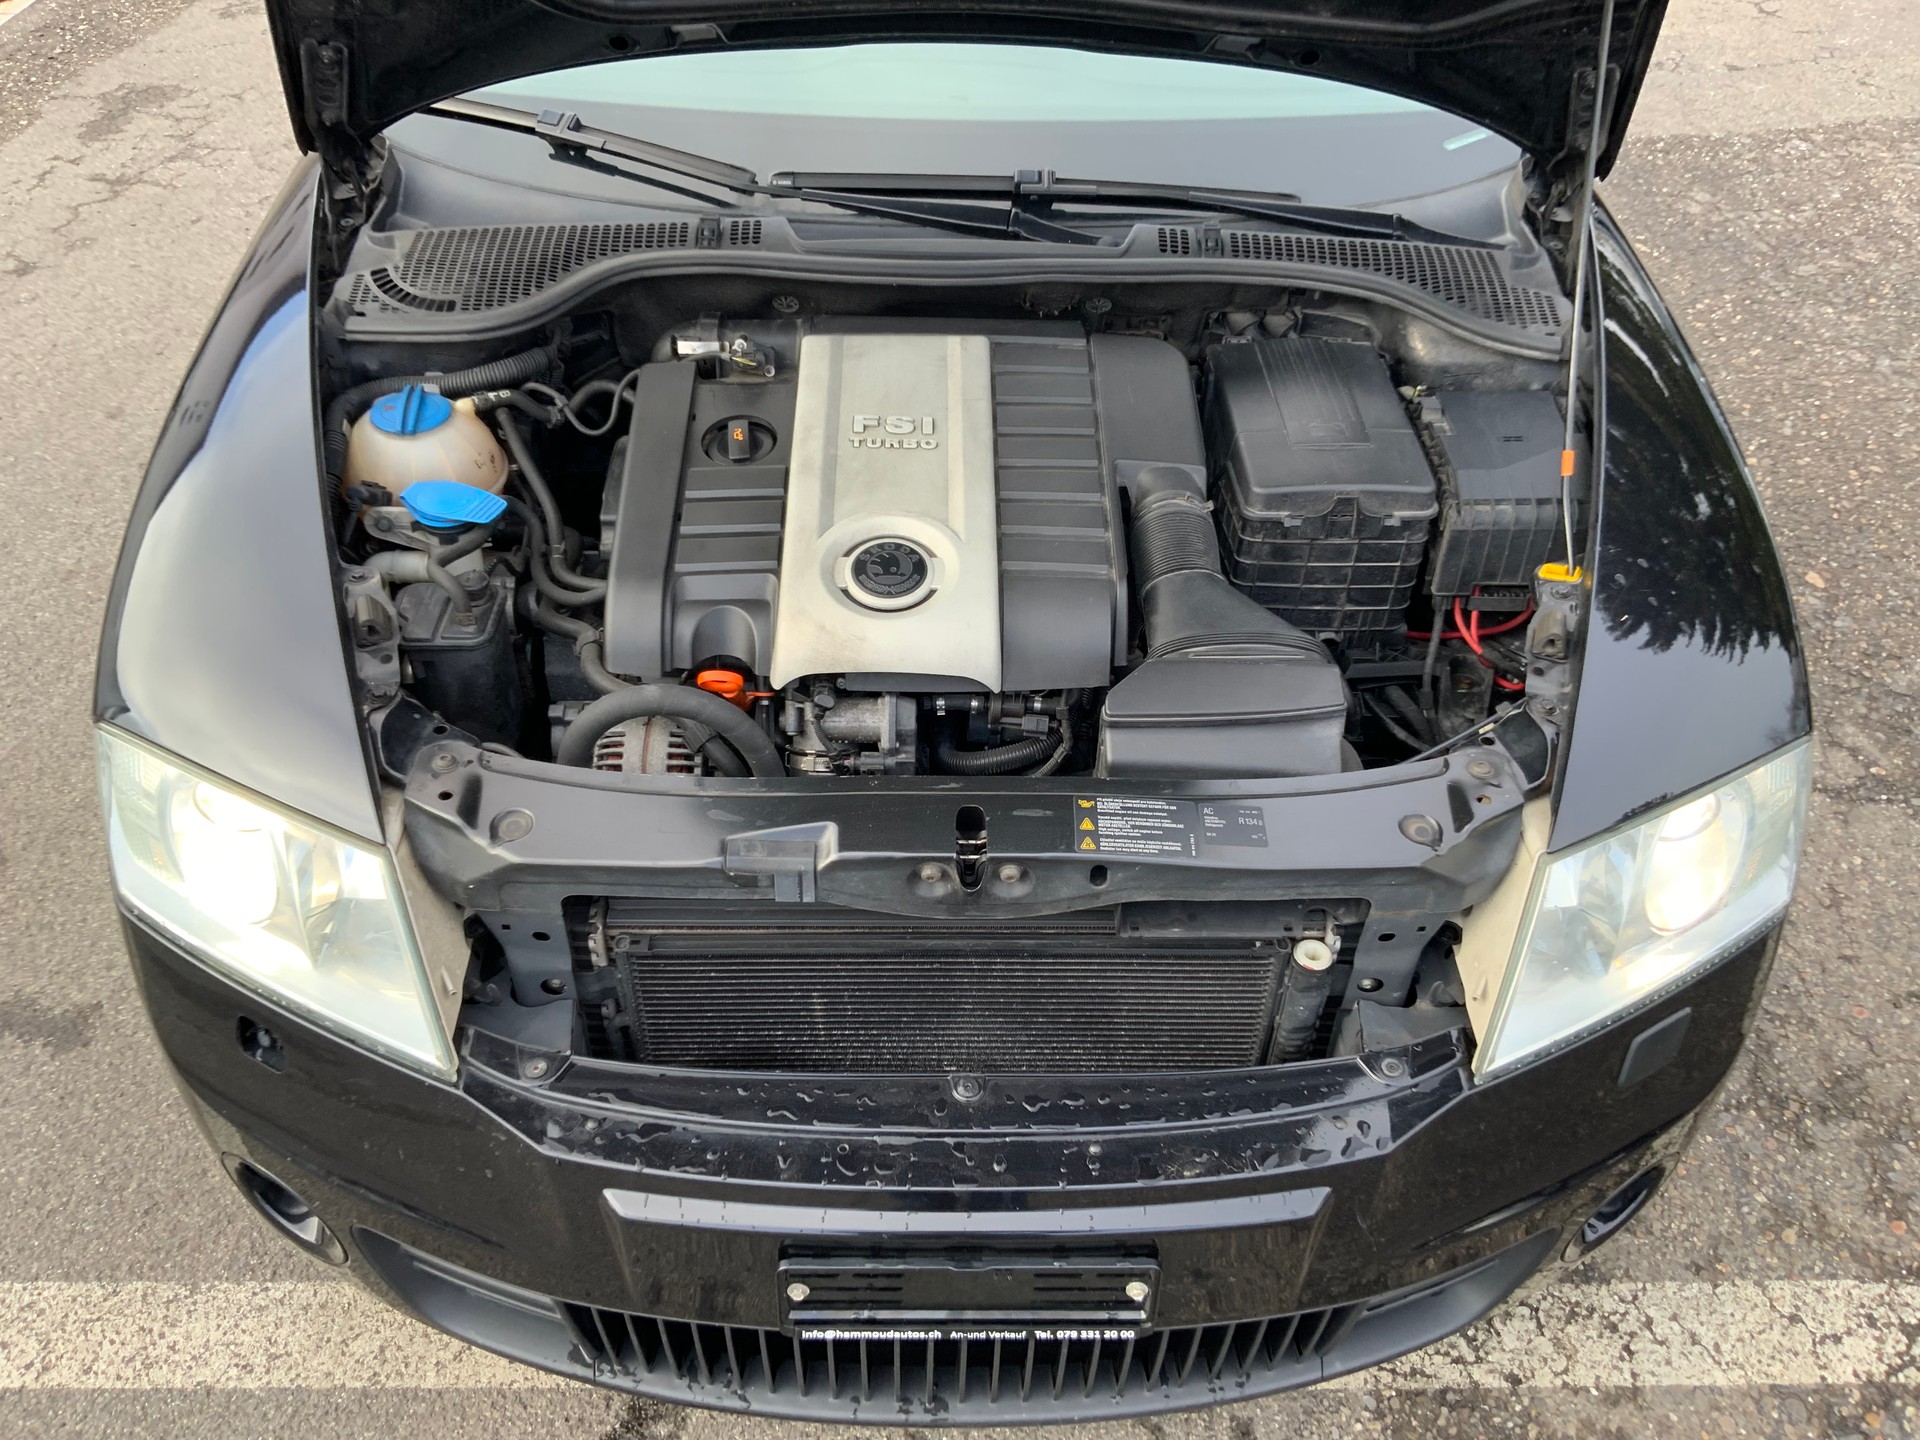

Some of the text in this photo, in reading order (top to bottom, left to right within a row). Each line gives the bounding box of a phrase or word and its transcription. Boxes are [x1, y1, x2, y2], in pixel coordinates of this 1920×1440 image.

[852, 414, 935, 435] FSI
[849, 437, 938, 450] TURBO
[1203, 807, 1214, 815] AC
[1245, 818, 1258, 826] 134
[950, 1330, 986, 1339] An-und
[988, 1330, 1027, 1339] Verkauf
[1034, 1330, 1054, 1339] Tel.
[1056, 1330, 1078, 1339] 079
[1080, 1330, 1100, 1339] 331
[1103, 1330, 1118, 1339] 20
[1119, 1330, 1135, 1339] 00
